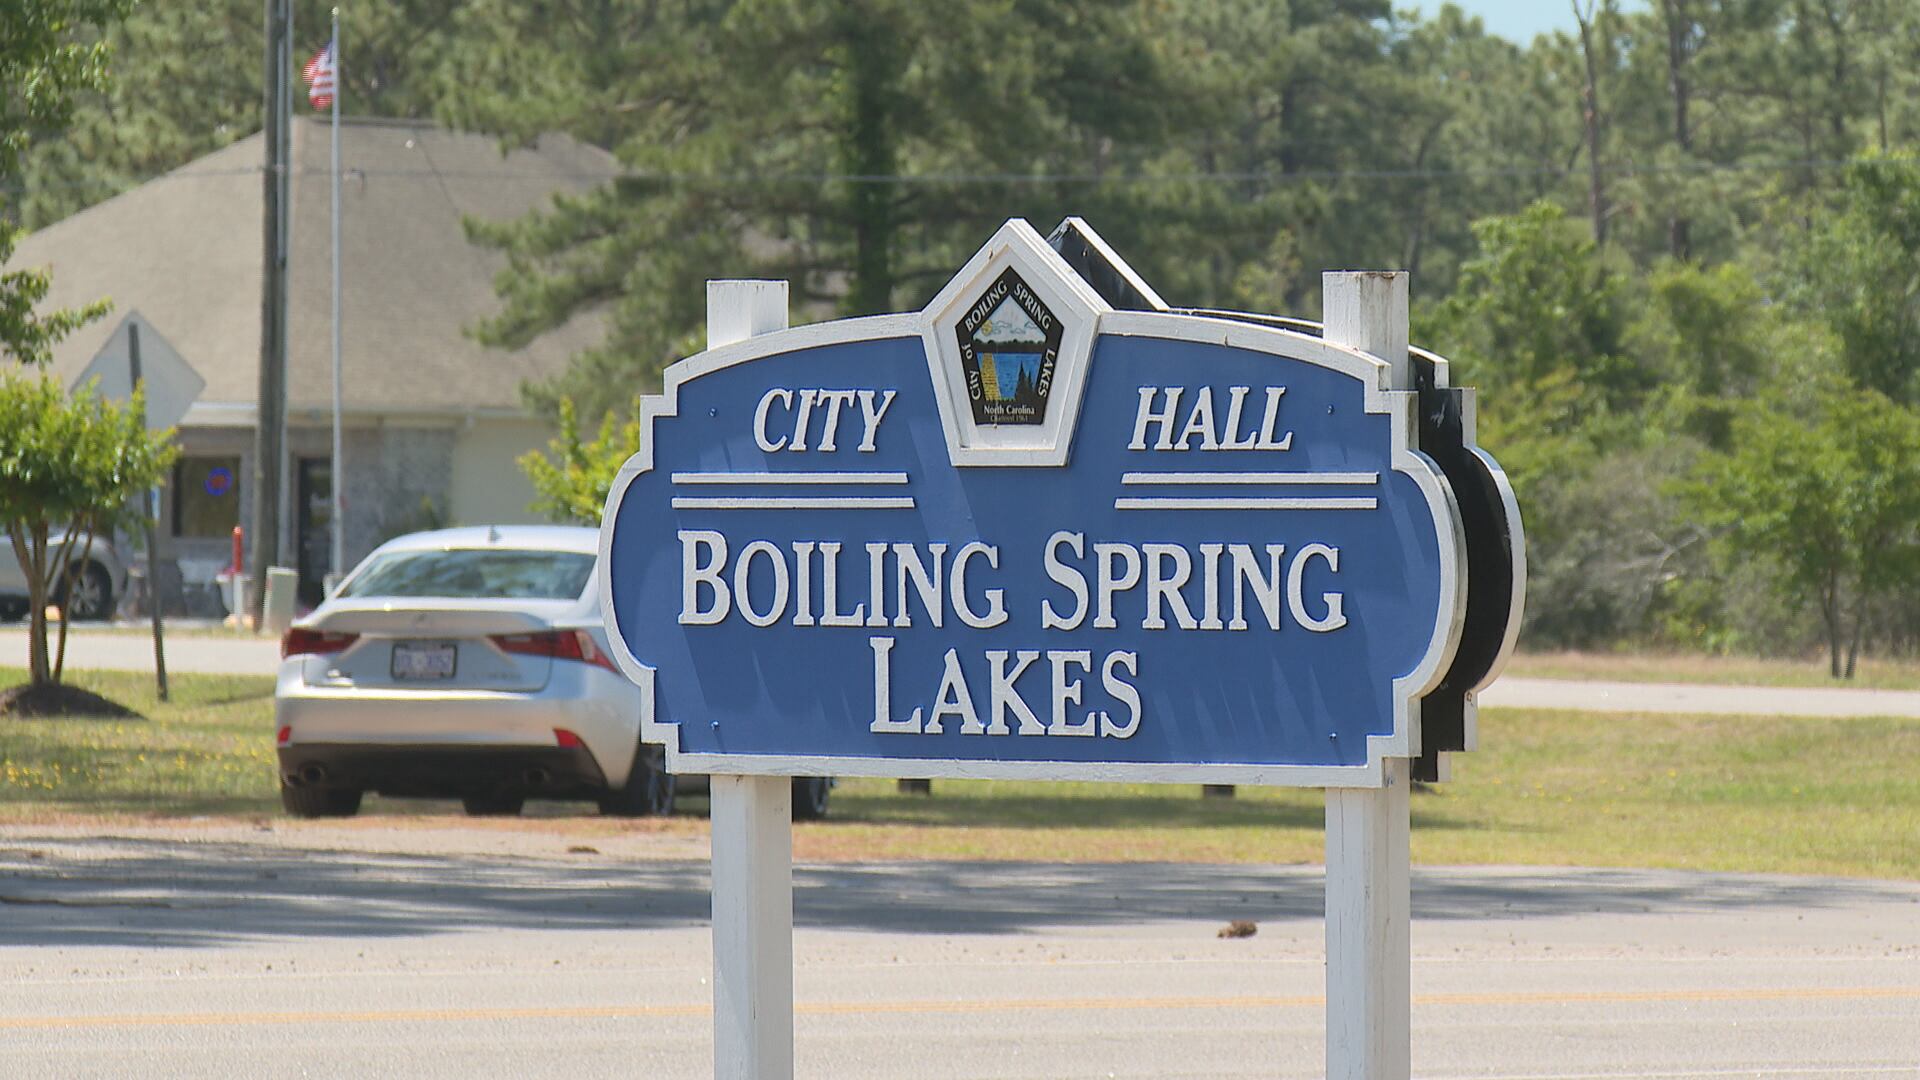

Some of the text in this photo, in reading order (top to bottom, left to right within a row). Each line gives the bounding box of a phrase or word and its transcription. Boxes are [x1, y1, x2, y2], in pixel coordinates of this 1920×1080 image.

[964, 280, 1008, 332] BOILING
[1013, 283, 1052, 330] SPRING
[961, 343, 974, 360] of
[1038, 348, 1056, 398] LAKES
[753, 386, 1294, 453] CITY HALL
[983, 405, 1035, 415] North Carolina
[677, 530, 1348, 632] BOILING SPRING
[870, 637, 1143, 739] LAKES
